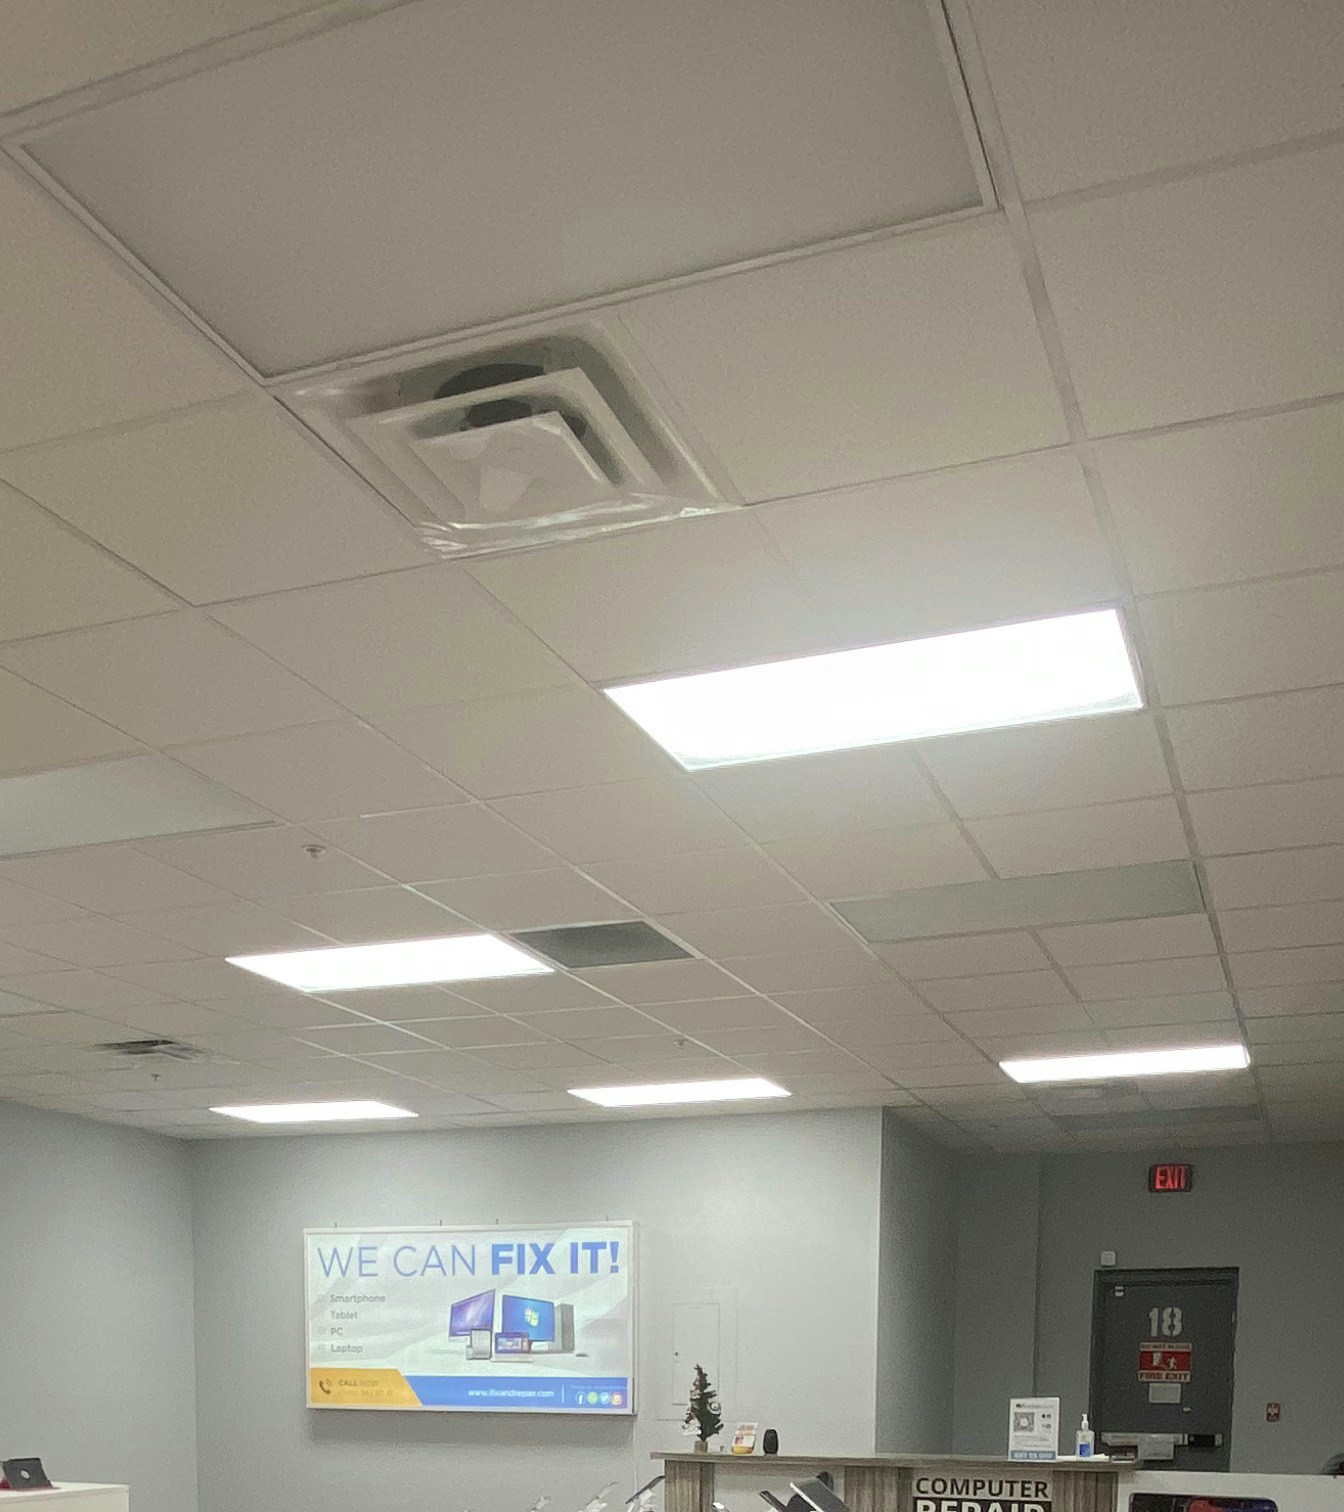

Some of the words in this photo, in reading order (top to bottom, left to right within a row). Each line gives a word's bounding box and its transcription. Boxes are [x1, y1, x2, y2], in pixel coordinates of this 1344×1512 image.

[1155, 1164, 1187, 1190] EXIT
[317, 1246, 378, 1278] WE
[393, 1244, 476, 1278] CAN
[491, 1241, 556, 1276] FIX
[570, 1240, 620, 1275] IT!
[329, 1292, 386, 1305] Smartphone
[330, 1310, 358, 1321] Tablet
[1148, 1306, 1183, 1338] 18
[330, 1326, 344, 1337] PC
[330, 1343, 363, 1355] Laptop
[1165, 1372, 1190, 1381] EXIT
[337, 1379, 358, 1388] CALL
[915, 1476, 1049, 1499] COMPUTER
